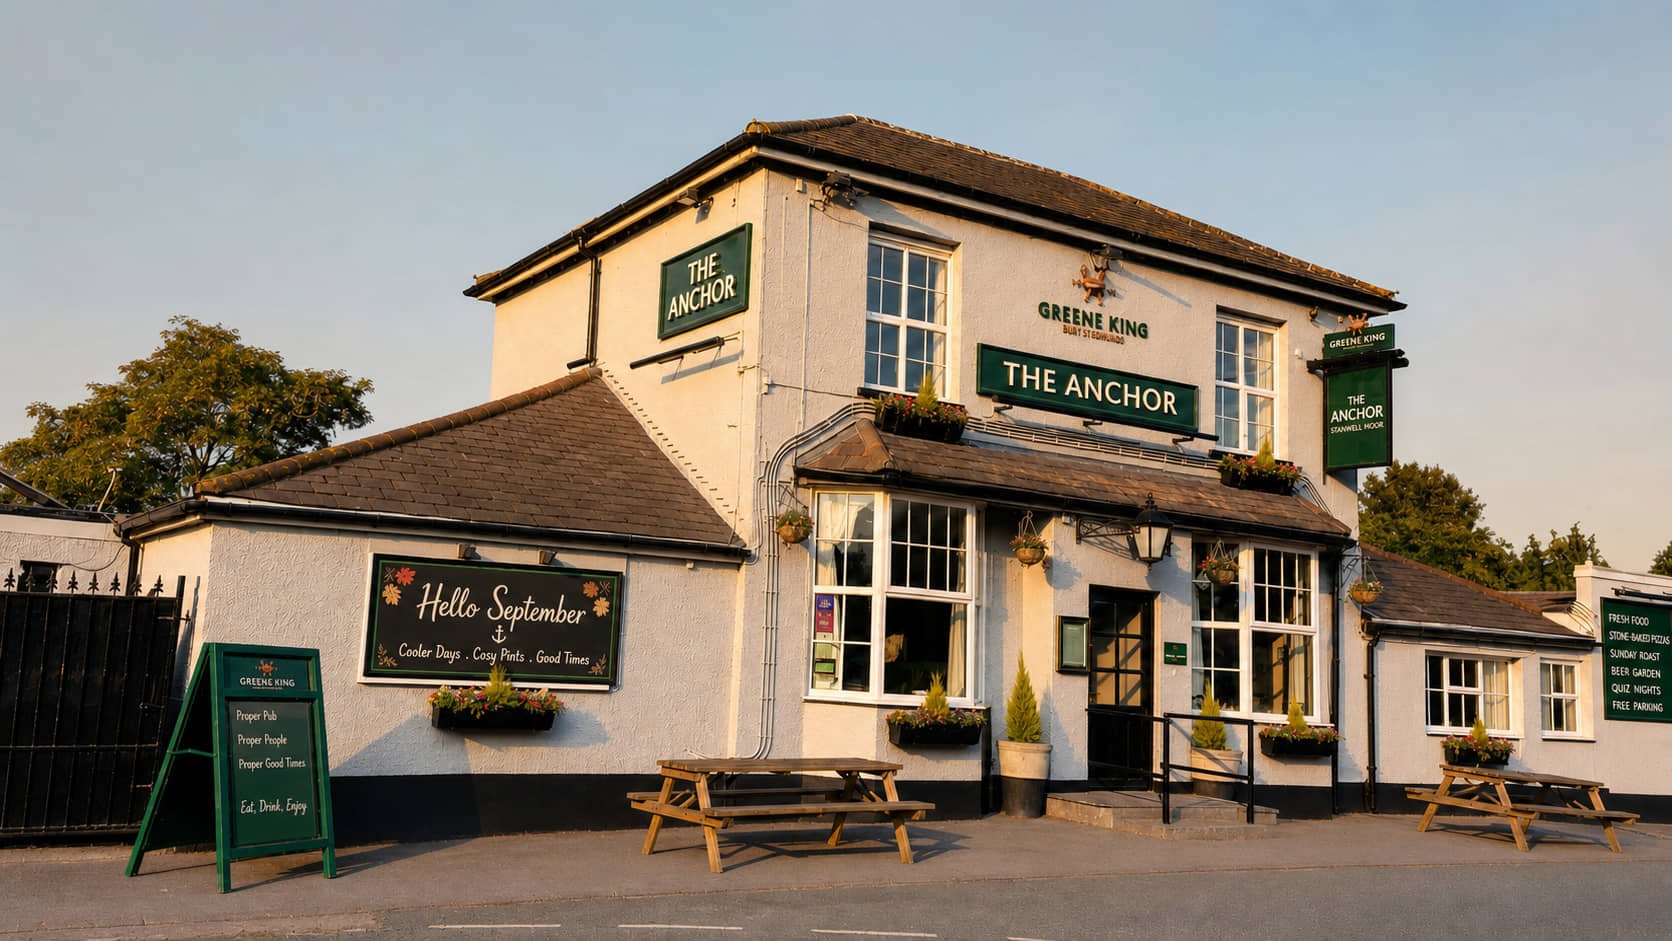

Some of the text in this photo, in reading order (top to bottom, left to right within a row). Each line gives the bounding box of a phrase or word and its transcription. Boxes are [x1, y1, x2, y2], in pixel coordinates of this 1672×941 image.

[688, 252, 717, 285] THE
[667, 274, 735, 320] ANCHOR
[1038, 301, 1148, 339] GREENE KING
[1329, 335, 1362, 349] GREENE
[1364, 332, 1386, 344] KING
[1003, 360, 1177, 416] THE ANCHOR
[1347, 394, 1366, 406] THE
[1330, 405, 1384, 423] ANCHOR
[1330, 421, 1384, 434] STANWELL MOOR
[416, 582, 587, 632] Hello September
[1608, 613, 1650, 626] FRESH FOOD
[399, 642, 432, 658] Cooler
[436, 644, 461, 664] Days
[472, 646, 497, 666] Cosy
[500, 648, 525, 662] Pints
[536, 650, 560, 664] Good
[564, 651, 590, 666] Times
[1609, 648, 1660, 662] SUNDAY ROAST
[1610, 666, 1661, 679] BEER GARDEN
[239, 677, 296, 688] GREENE KING
[1611, 683, 1662, 696] QUIZ NIGHTS
[1612, 700, 1664, 713] FREE PARKING
[236, 710, 278, 724] Proper Pub
[238, 734, 288, 748] Proper People
[238, 757, 306, 773] Proper Good Times
[240, 800, 257, 815] Eat,
[286, 798, 308, 816] Enjoy
